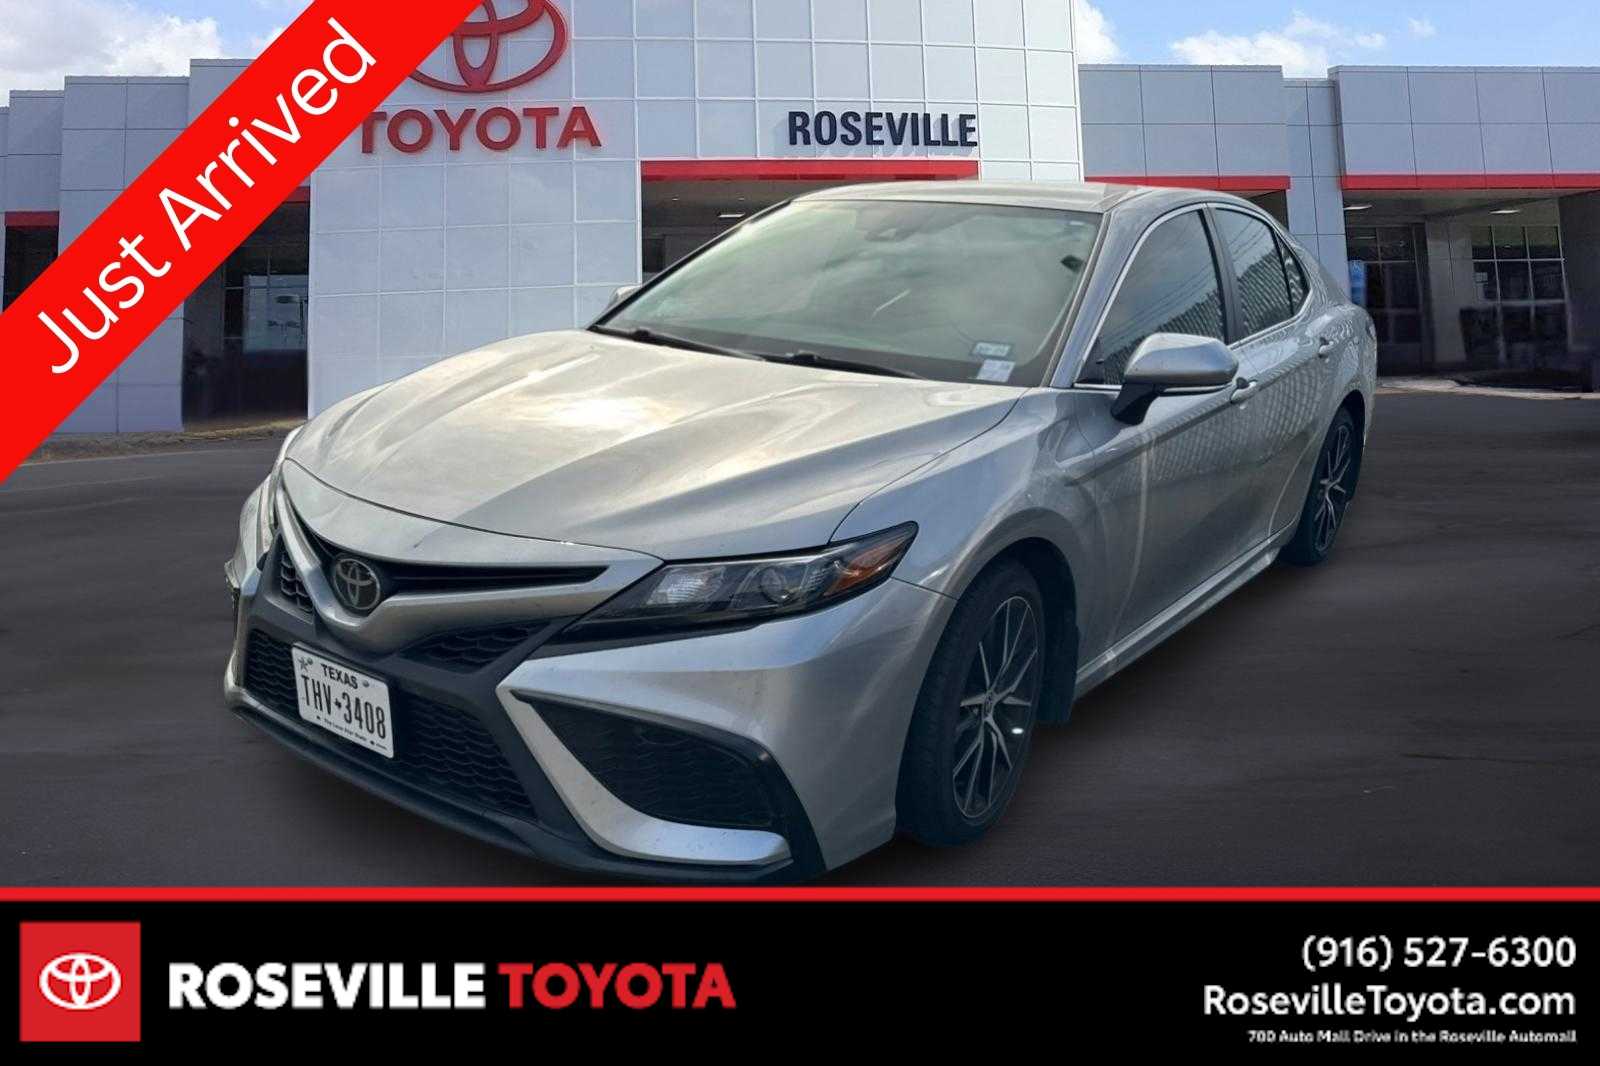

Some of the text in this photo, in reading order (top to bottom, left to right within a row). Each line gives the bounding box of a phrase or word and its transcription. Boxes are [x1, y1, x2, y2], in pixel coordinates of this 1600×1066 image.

[361, 106, 602, 154] TOYOTA
[788, 110, 978, 147] ROSEVILLE
[320, 663, 358, 690] TEXAS
